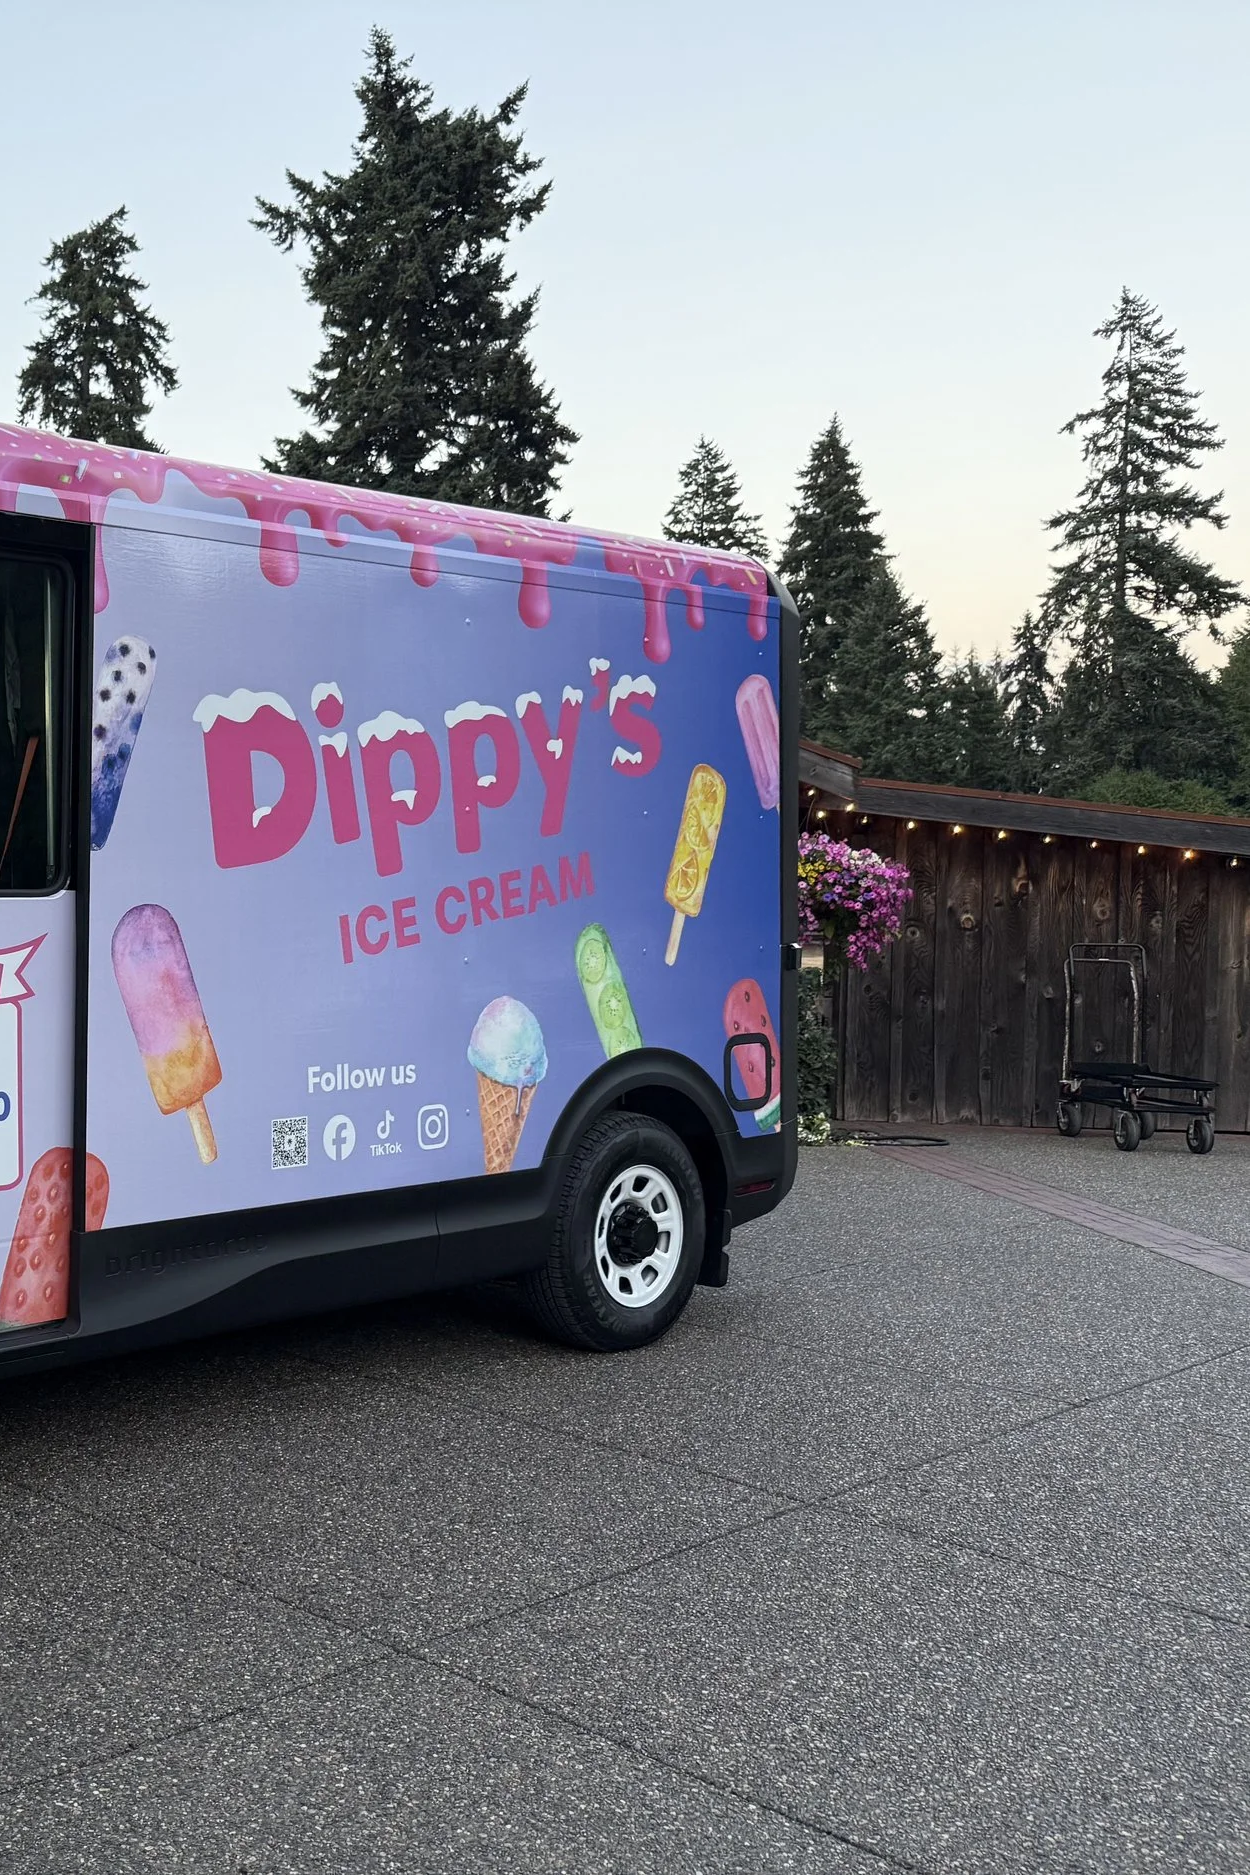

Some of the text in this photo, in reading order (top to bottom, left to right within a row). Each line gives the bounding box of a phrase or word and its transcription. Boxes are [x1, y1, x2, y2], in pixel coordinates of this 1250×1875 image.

[192, 657, 662, 877] Dippy's
[338, 851, 596, 965] ICE CREAM
[307, 1063, 417, 1094] Follow us
[369, 1142, 402, 1157] TikTok
